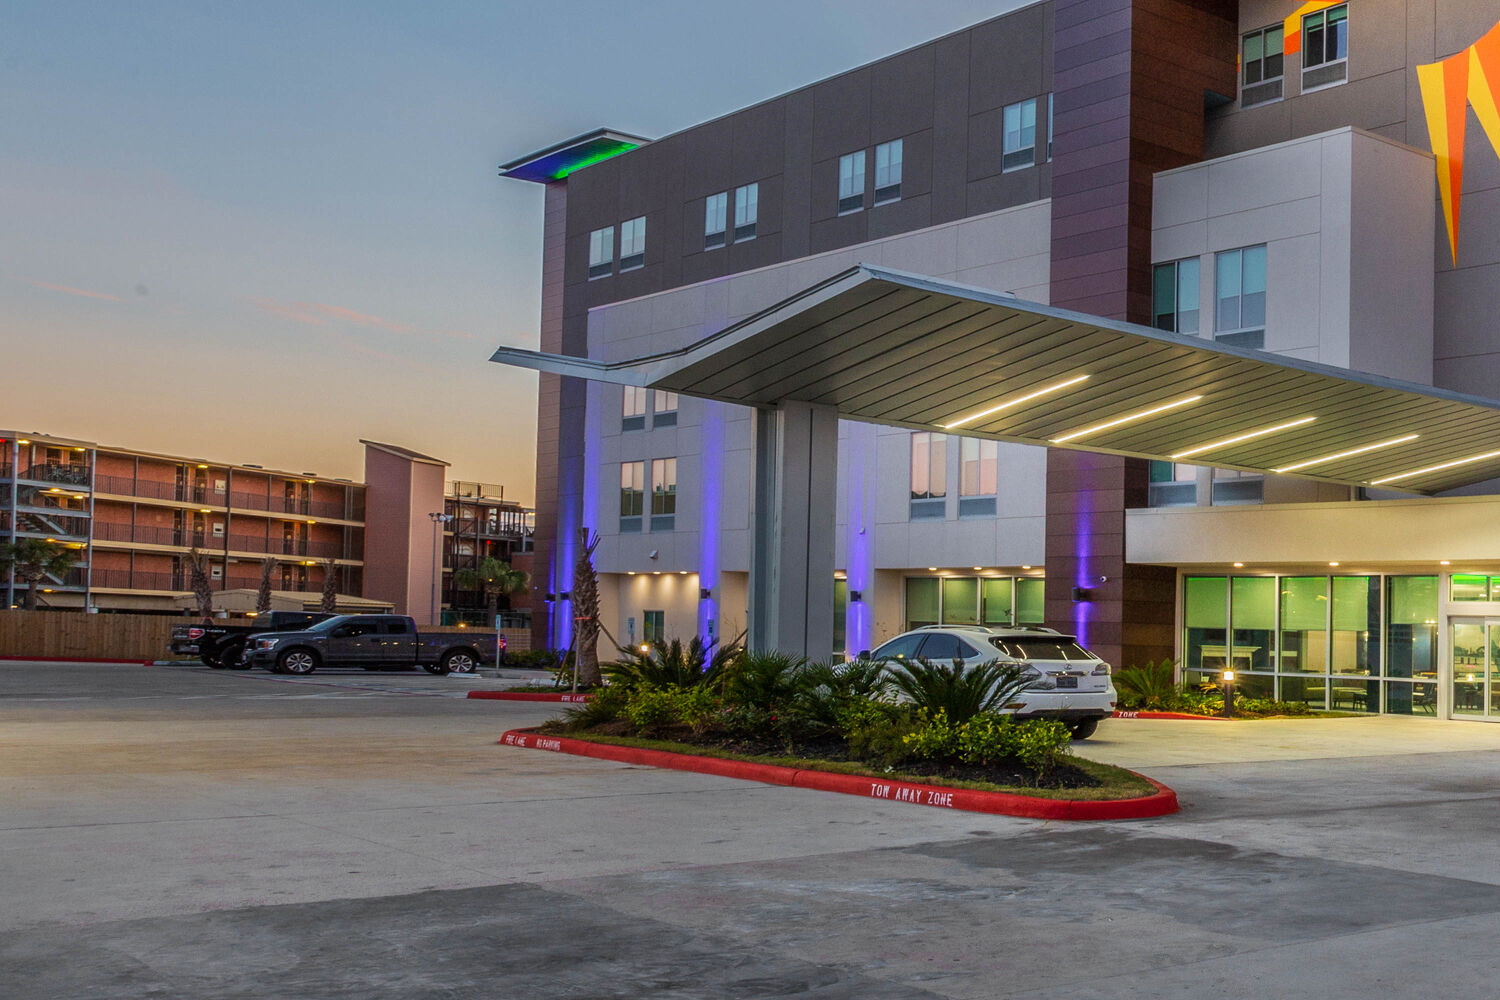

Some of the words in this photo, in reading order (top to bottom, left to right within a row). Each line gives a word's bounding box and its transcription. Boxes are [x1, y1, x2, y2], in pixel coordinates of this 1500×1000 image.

[871, 783, 890, 798] TOW
[895, 787, 922, 803] AWAY
[927, 791, 954, 807] ZONE
